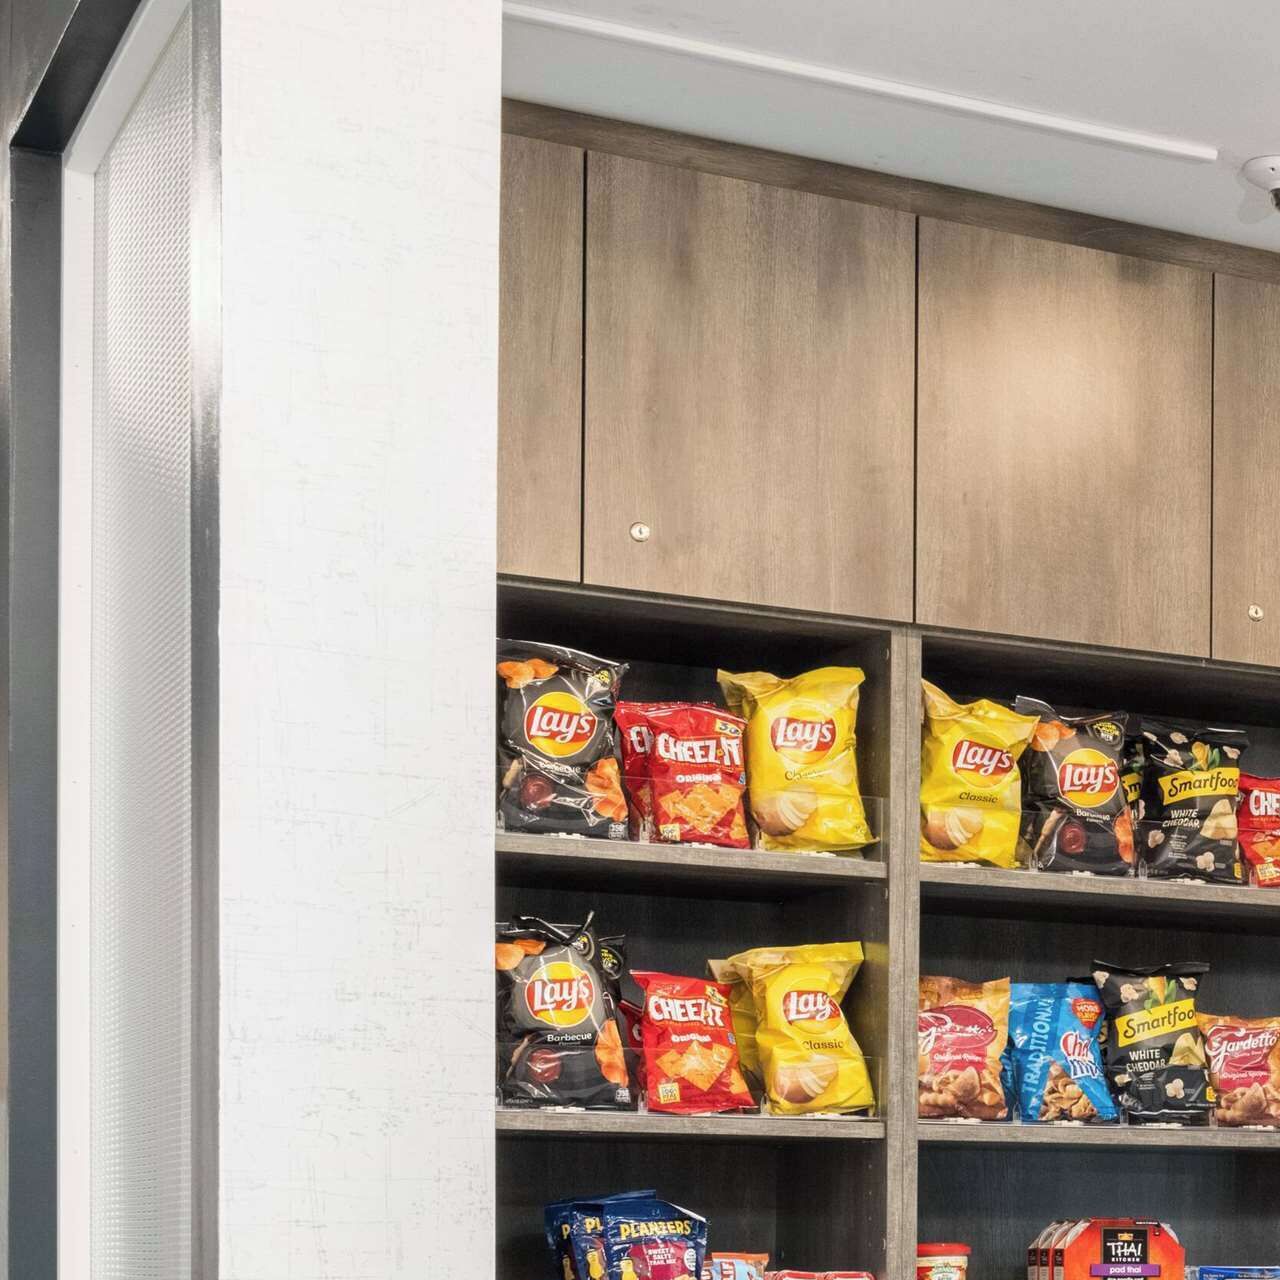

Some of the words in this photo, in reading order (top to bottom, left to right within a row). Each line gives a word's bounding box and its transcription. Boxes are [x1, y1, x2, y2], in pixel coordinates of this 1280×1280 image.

[959, 791, 998, 803] Classic
[1171, 809, 1199, 819] WHITE
[547, 1033, 592, 1042] Barbecue
[1129, 1049, 1161, 1061] WHITE
[1126, 1060, 1166, 1073] CHEDDAR
[620, 1220, 692, 1241] PLANTERS
[1107, 1242, 1142, 1256] THAI
[1110, 1266, 1125, 1274] pad
[1127, 1265, 1142, 1274] thai
